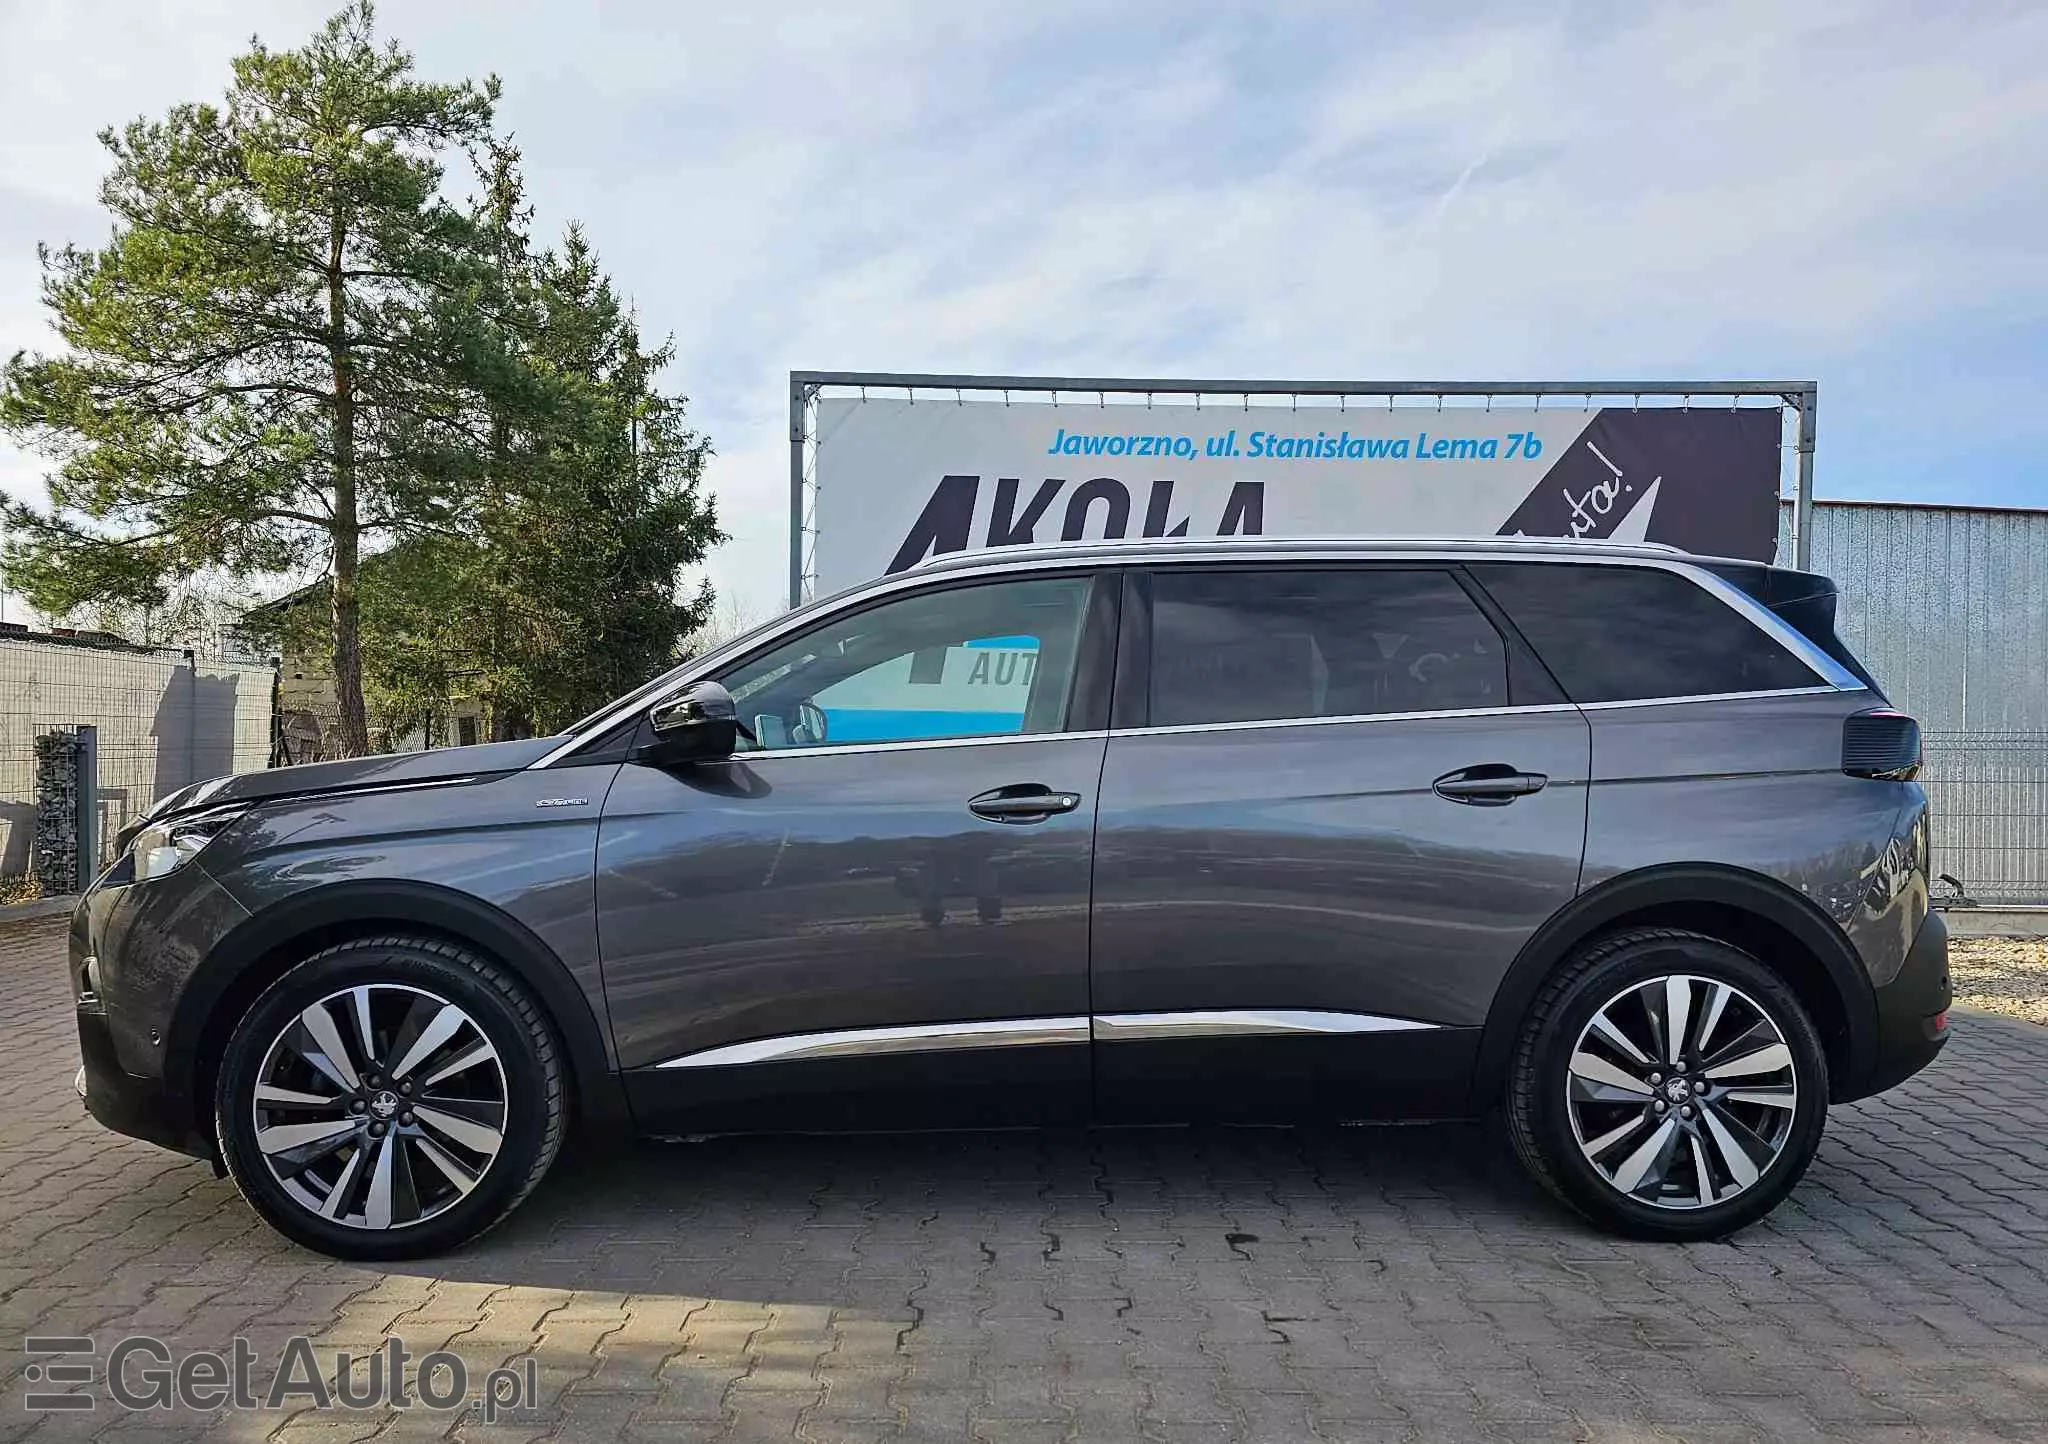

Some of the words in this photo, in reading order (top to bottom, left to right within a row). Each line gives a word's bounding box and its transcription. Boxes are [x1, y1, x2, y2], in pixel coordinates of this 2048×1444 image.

[1048, 429, 1199, 460] Jaworzno,
[1206, 430, 1240, 457] ul.
[1247, 431, 1410, 458] Stanisława
[1416, 432, 1498, 459] Lema
[1504, 432, 1543, 459] 7b
